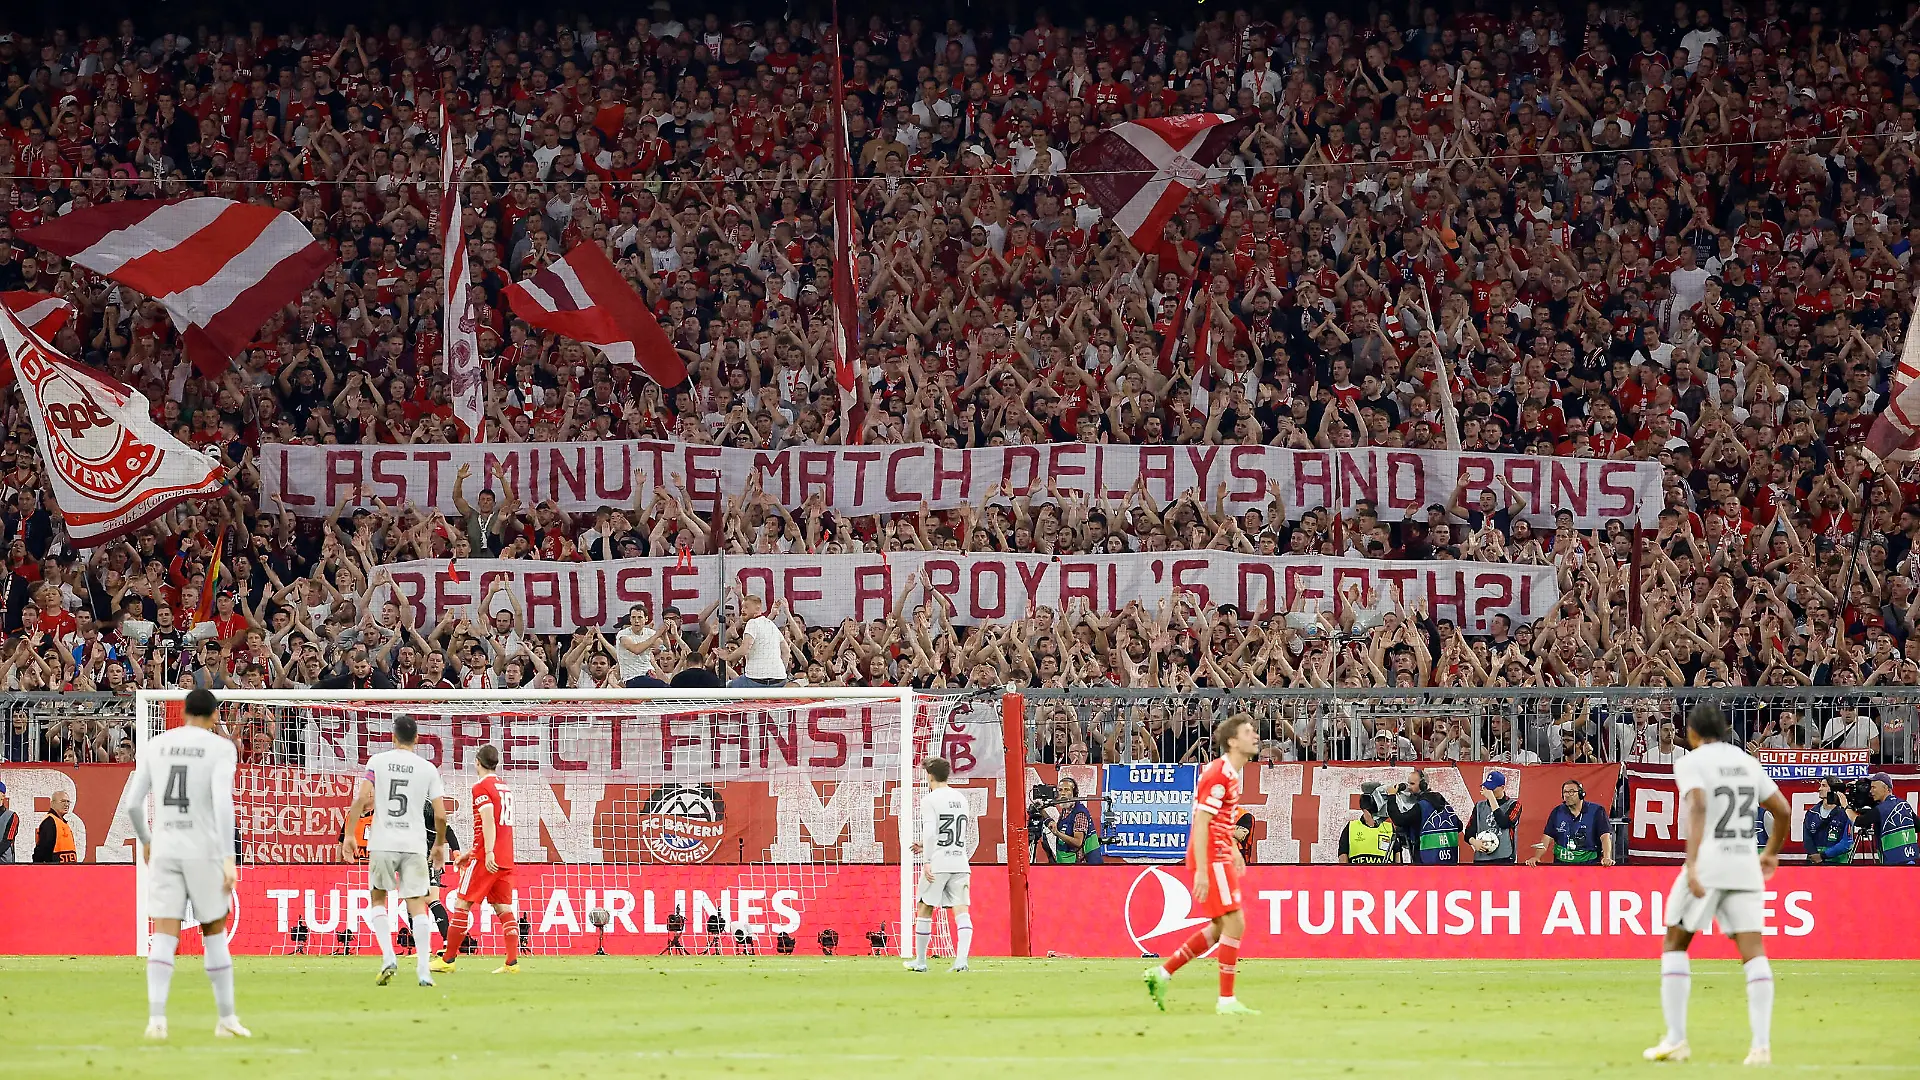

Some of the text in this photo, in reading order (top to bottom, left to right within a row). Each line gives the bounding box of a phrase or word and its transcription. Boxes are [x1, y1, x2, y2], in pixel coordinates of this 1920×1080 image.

[52, 435, 122, 489] BAYERN
[280, 442, 1637, 518] LAST MINUTE MATCH DELAYS AND BANS
[389, 559, 1532, 630] BECAUSE OF A ROYAL'S DEATH?!
[311, 707, 873, 771] RESPECT FANS!
[231, 768, 353, 797] ULTRAS
[388, 763, 414, 774] SERGIO
[1129, 768, 1175, 783] GUTE
[163, 765, 190, 814] 4
[387, 778, 409, 818] 5
[1110, 789, 1192, 804] FREUNDE
[234, 804, 350, 836] GEGEN
[499, 790, 515, 826] 18
[1112, 811, 1188, 825] SIND NIE
[1714, 785, 1756, 838] 23
[642, 818, 724, 837] FC BAYERN
[936, 813, 969, 848] 30
[1116, 833, 1186, 848] ALLEIN!
[652, 838, 709, 863] MÜNCHEN
[539, 888, 801, 934] AIRLINES
[1259, 890, 1816, 936] TURKISH AIRLES
